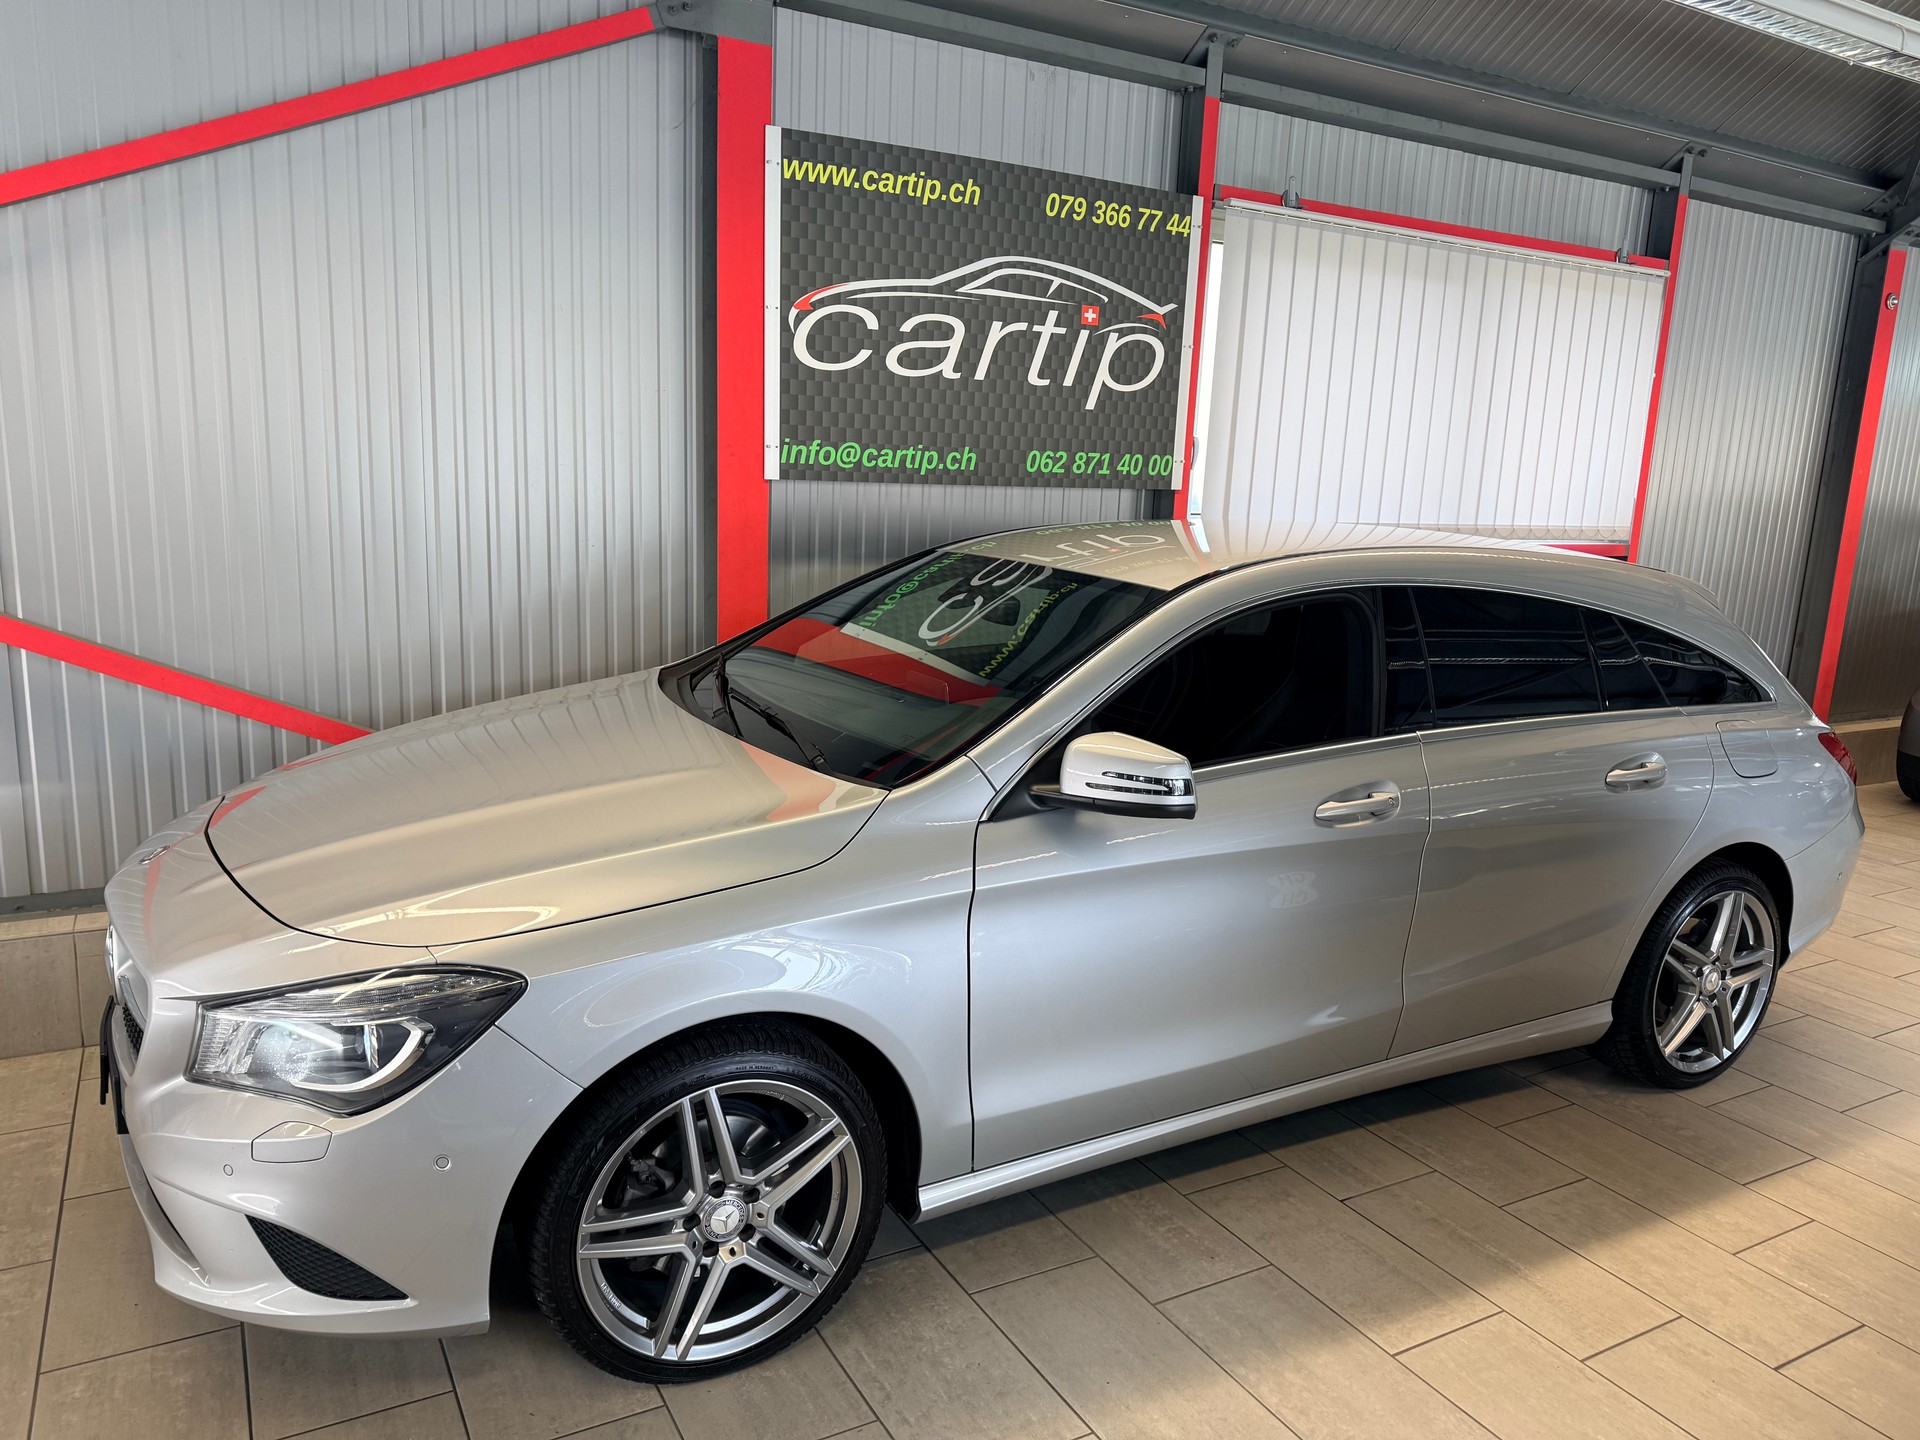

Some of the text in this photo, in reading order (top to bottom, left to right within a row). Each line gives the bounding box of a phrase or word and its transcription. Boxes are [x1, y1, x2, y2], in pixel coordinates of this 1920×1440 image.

[782, 157, 981, 205] www.cartip.ch
[1045, 193, 1191, 238] 079 366 77 44
[793, 304, 1166, 410] cartip
[781, 438, 977, 475] info@cartip.ch
[1026, 450, 1173, 476] 062 871 40 00
